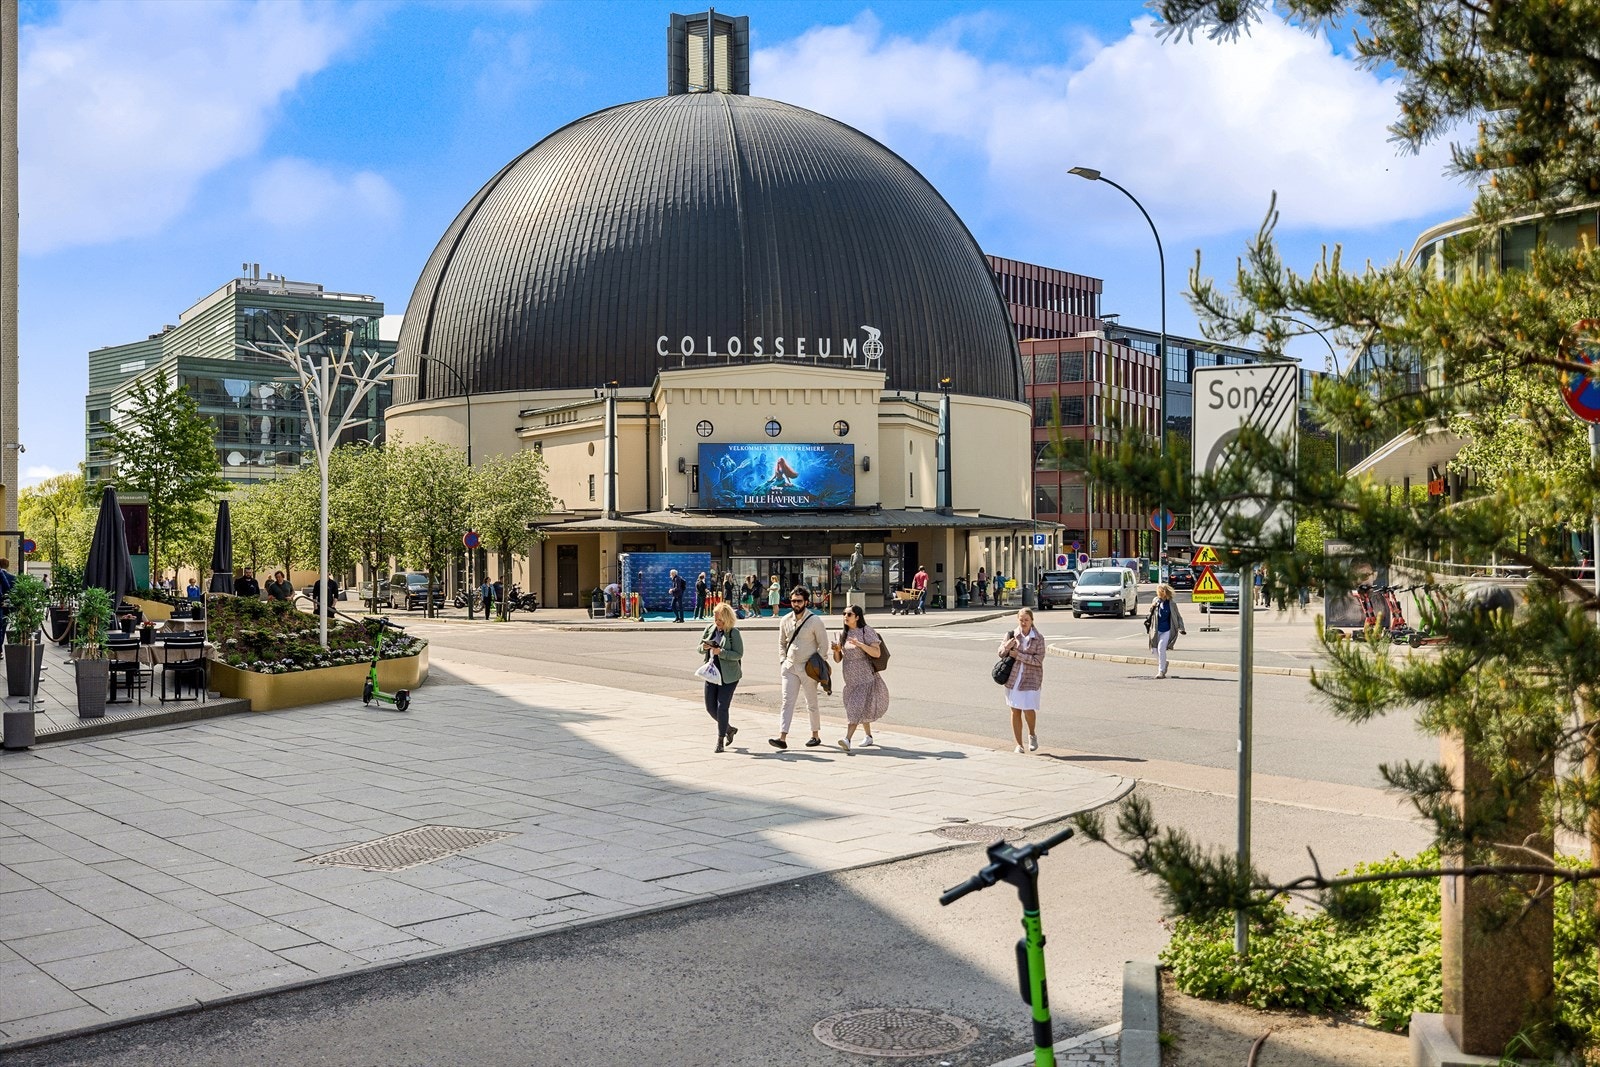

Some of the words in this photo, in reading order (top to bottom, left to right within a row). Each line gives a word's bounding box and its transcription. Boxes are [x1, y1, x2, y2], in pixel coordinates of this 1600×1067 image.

[656, 335, 857, 359] COLOSSEUM
[1208, 379, 1275, 410] Sone
[744, 494, 766, 504] LILLE
[767, 494, 810, 507] HAVFRUEN
[1036, 535, 1042, 544] P
